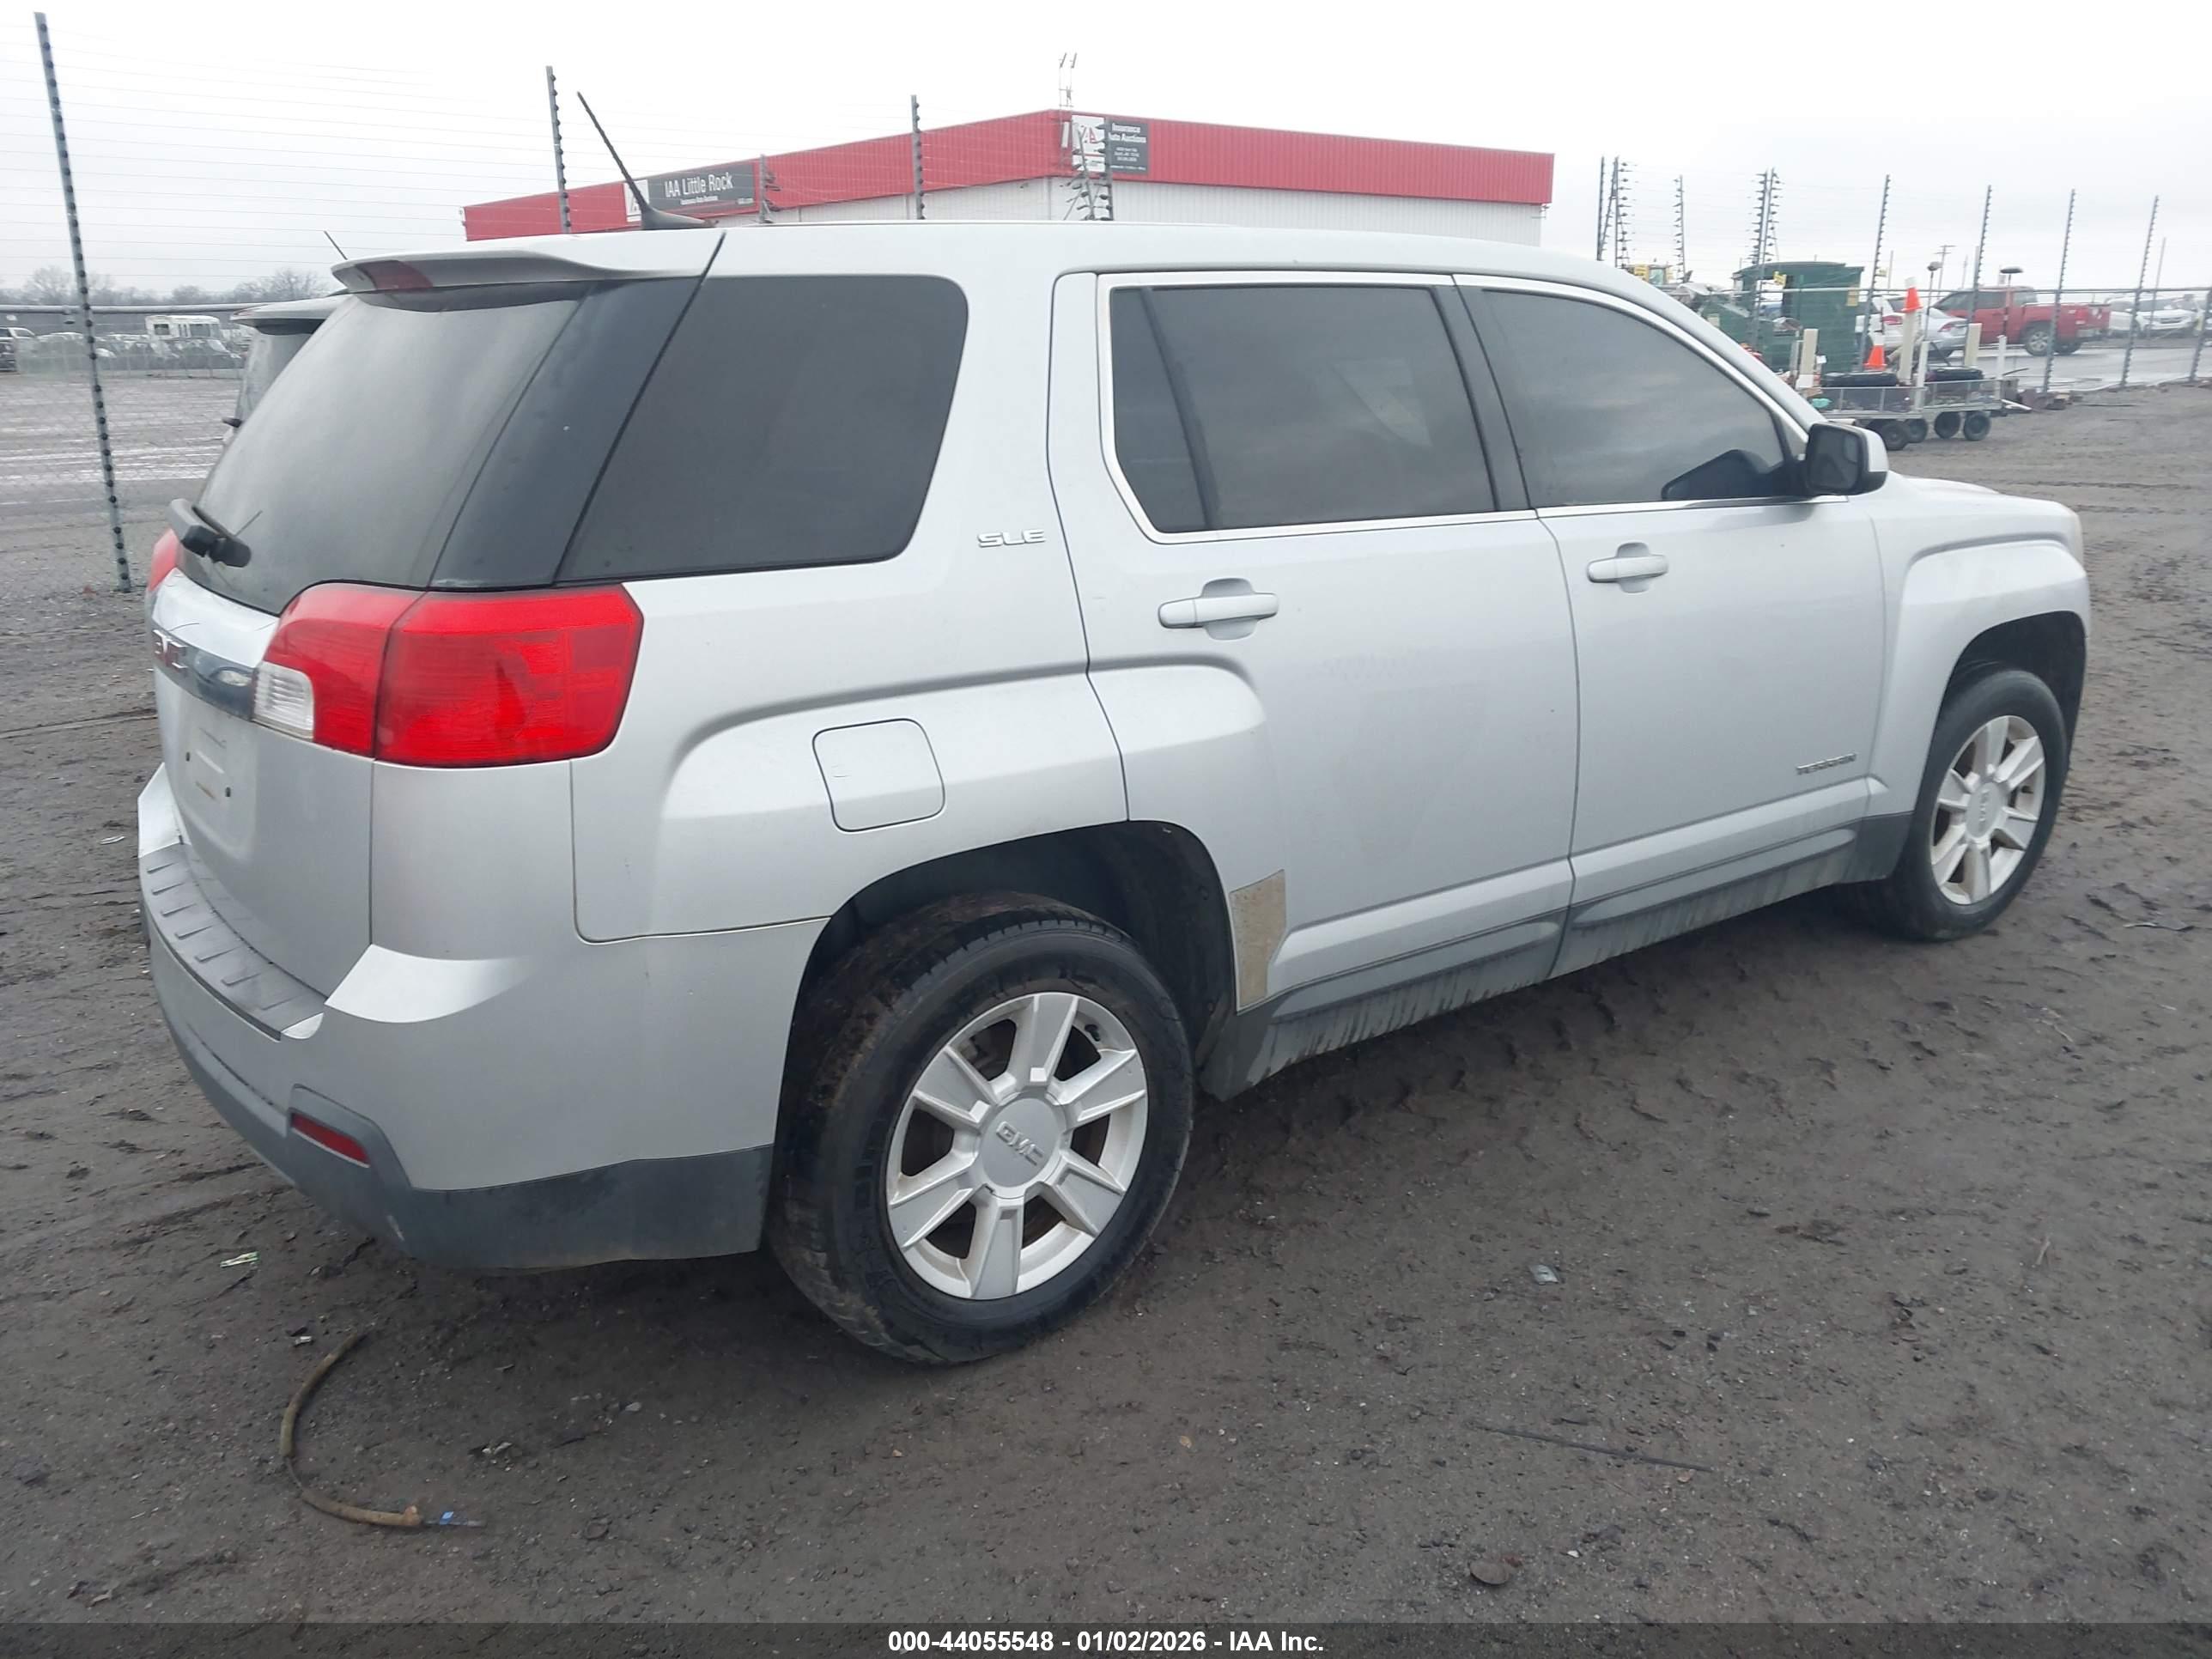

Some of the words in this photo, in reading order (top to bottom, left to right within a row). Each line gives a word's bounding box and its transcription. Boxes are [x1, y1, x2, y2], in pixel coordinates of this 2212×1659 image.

[664, 179, 681, 198] IAA
[682, 176, 706, 195] Little
[708, 172, 733, 192] Rock
[977, 529, 1046, 549] SLE
[995, 1121, 1045, 1167] GMC
